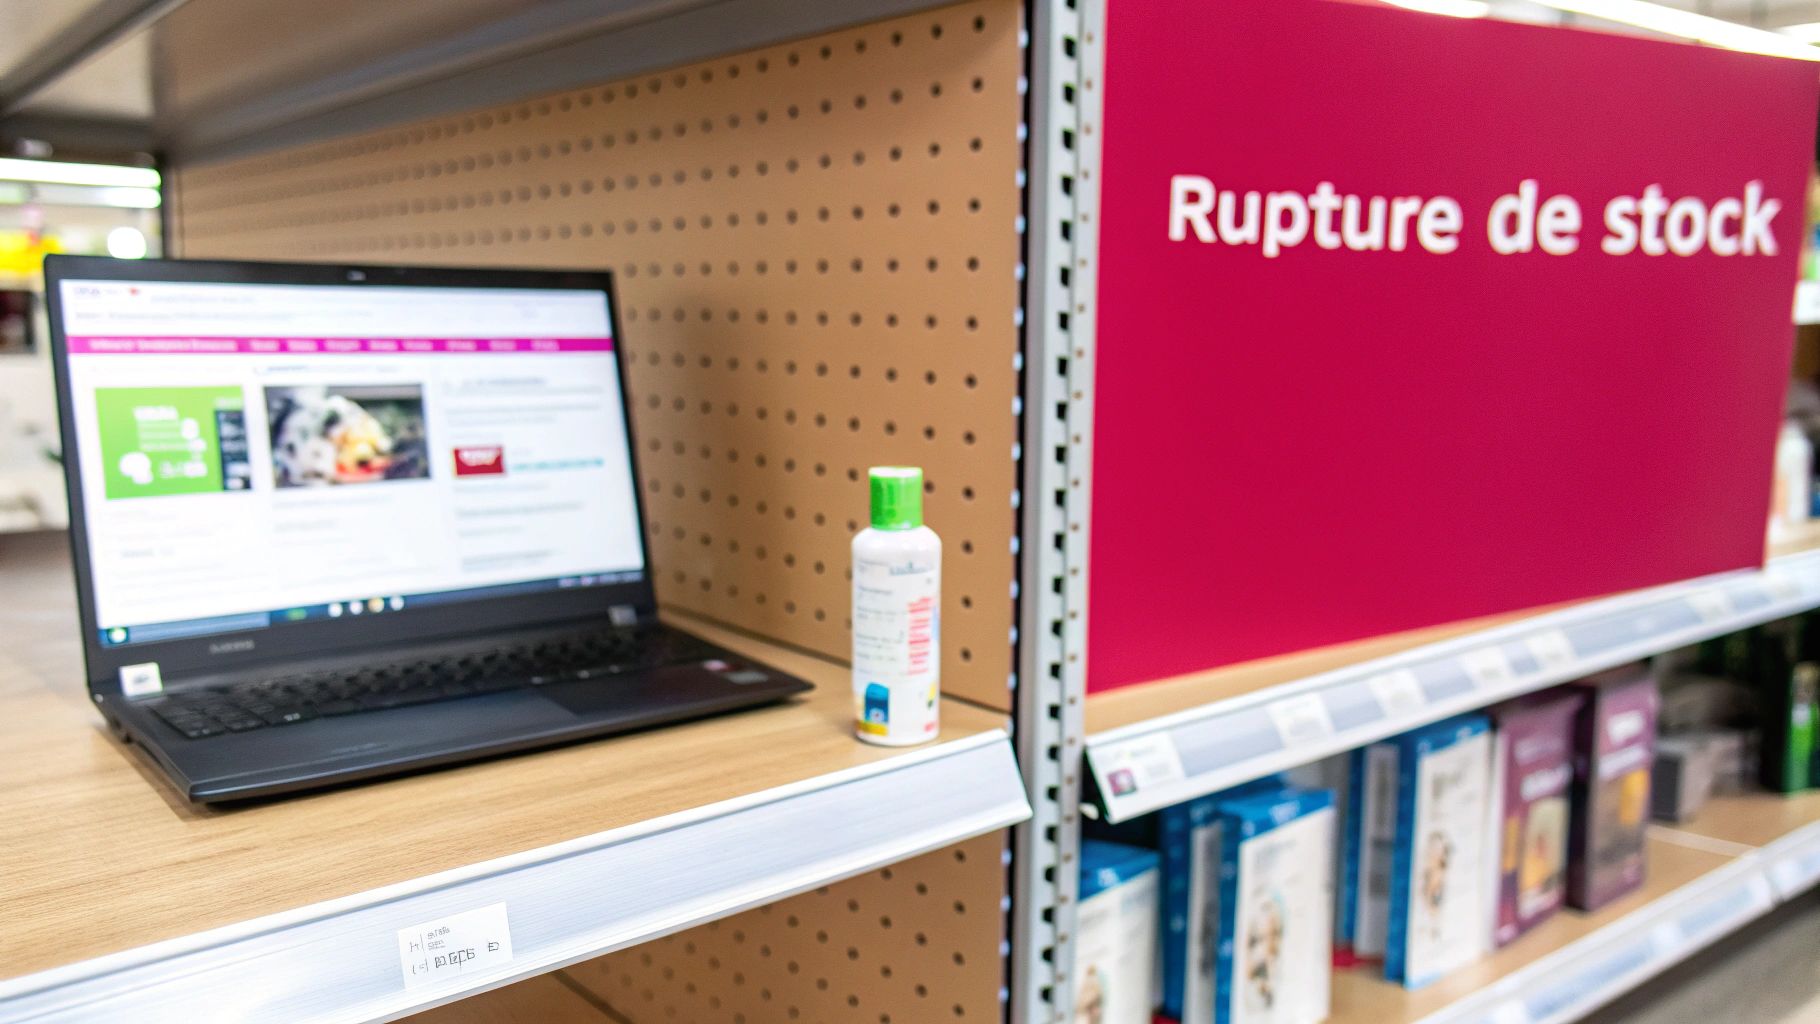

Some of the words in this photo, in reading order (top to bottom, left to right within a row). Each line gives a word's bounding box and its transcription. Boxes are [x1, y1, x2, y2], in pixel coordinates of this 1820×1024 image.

[1168, 175, 1462, 258] Rupture
[1487, 179, 1582, 256] de
[1601, 180, 1780, 257] stock
